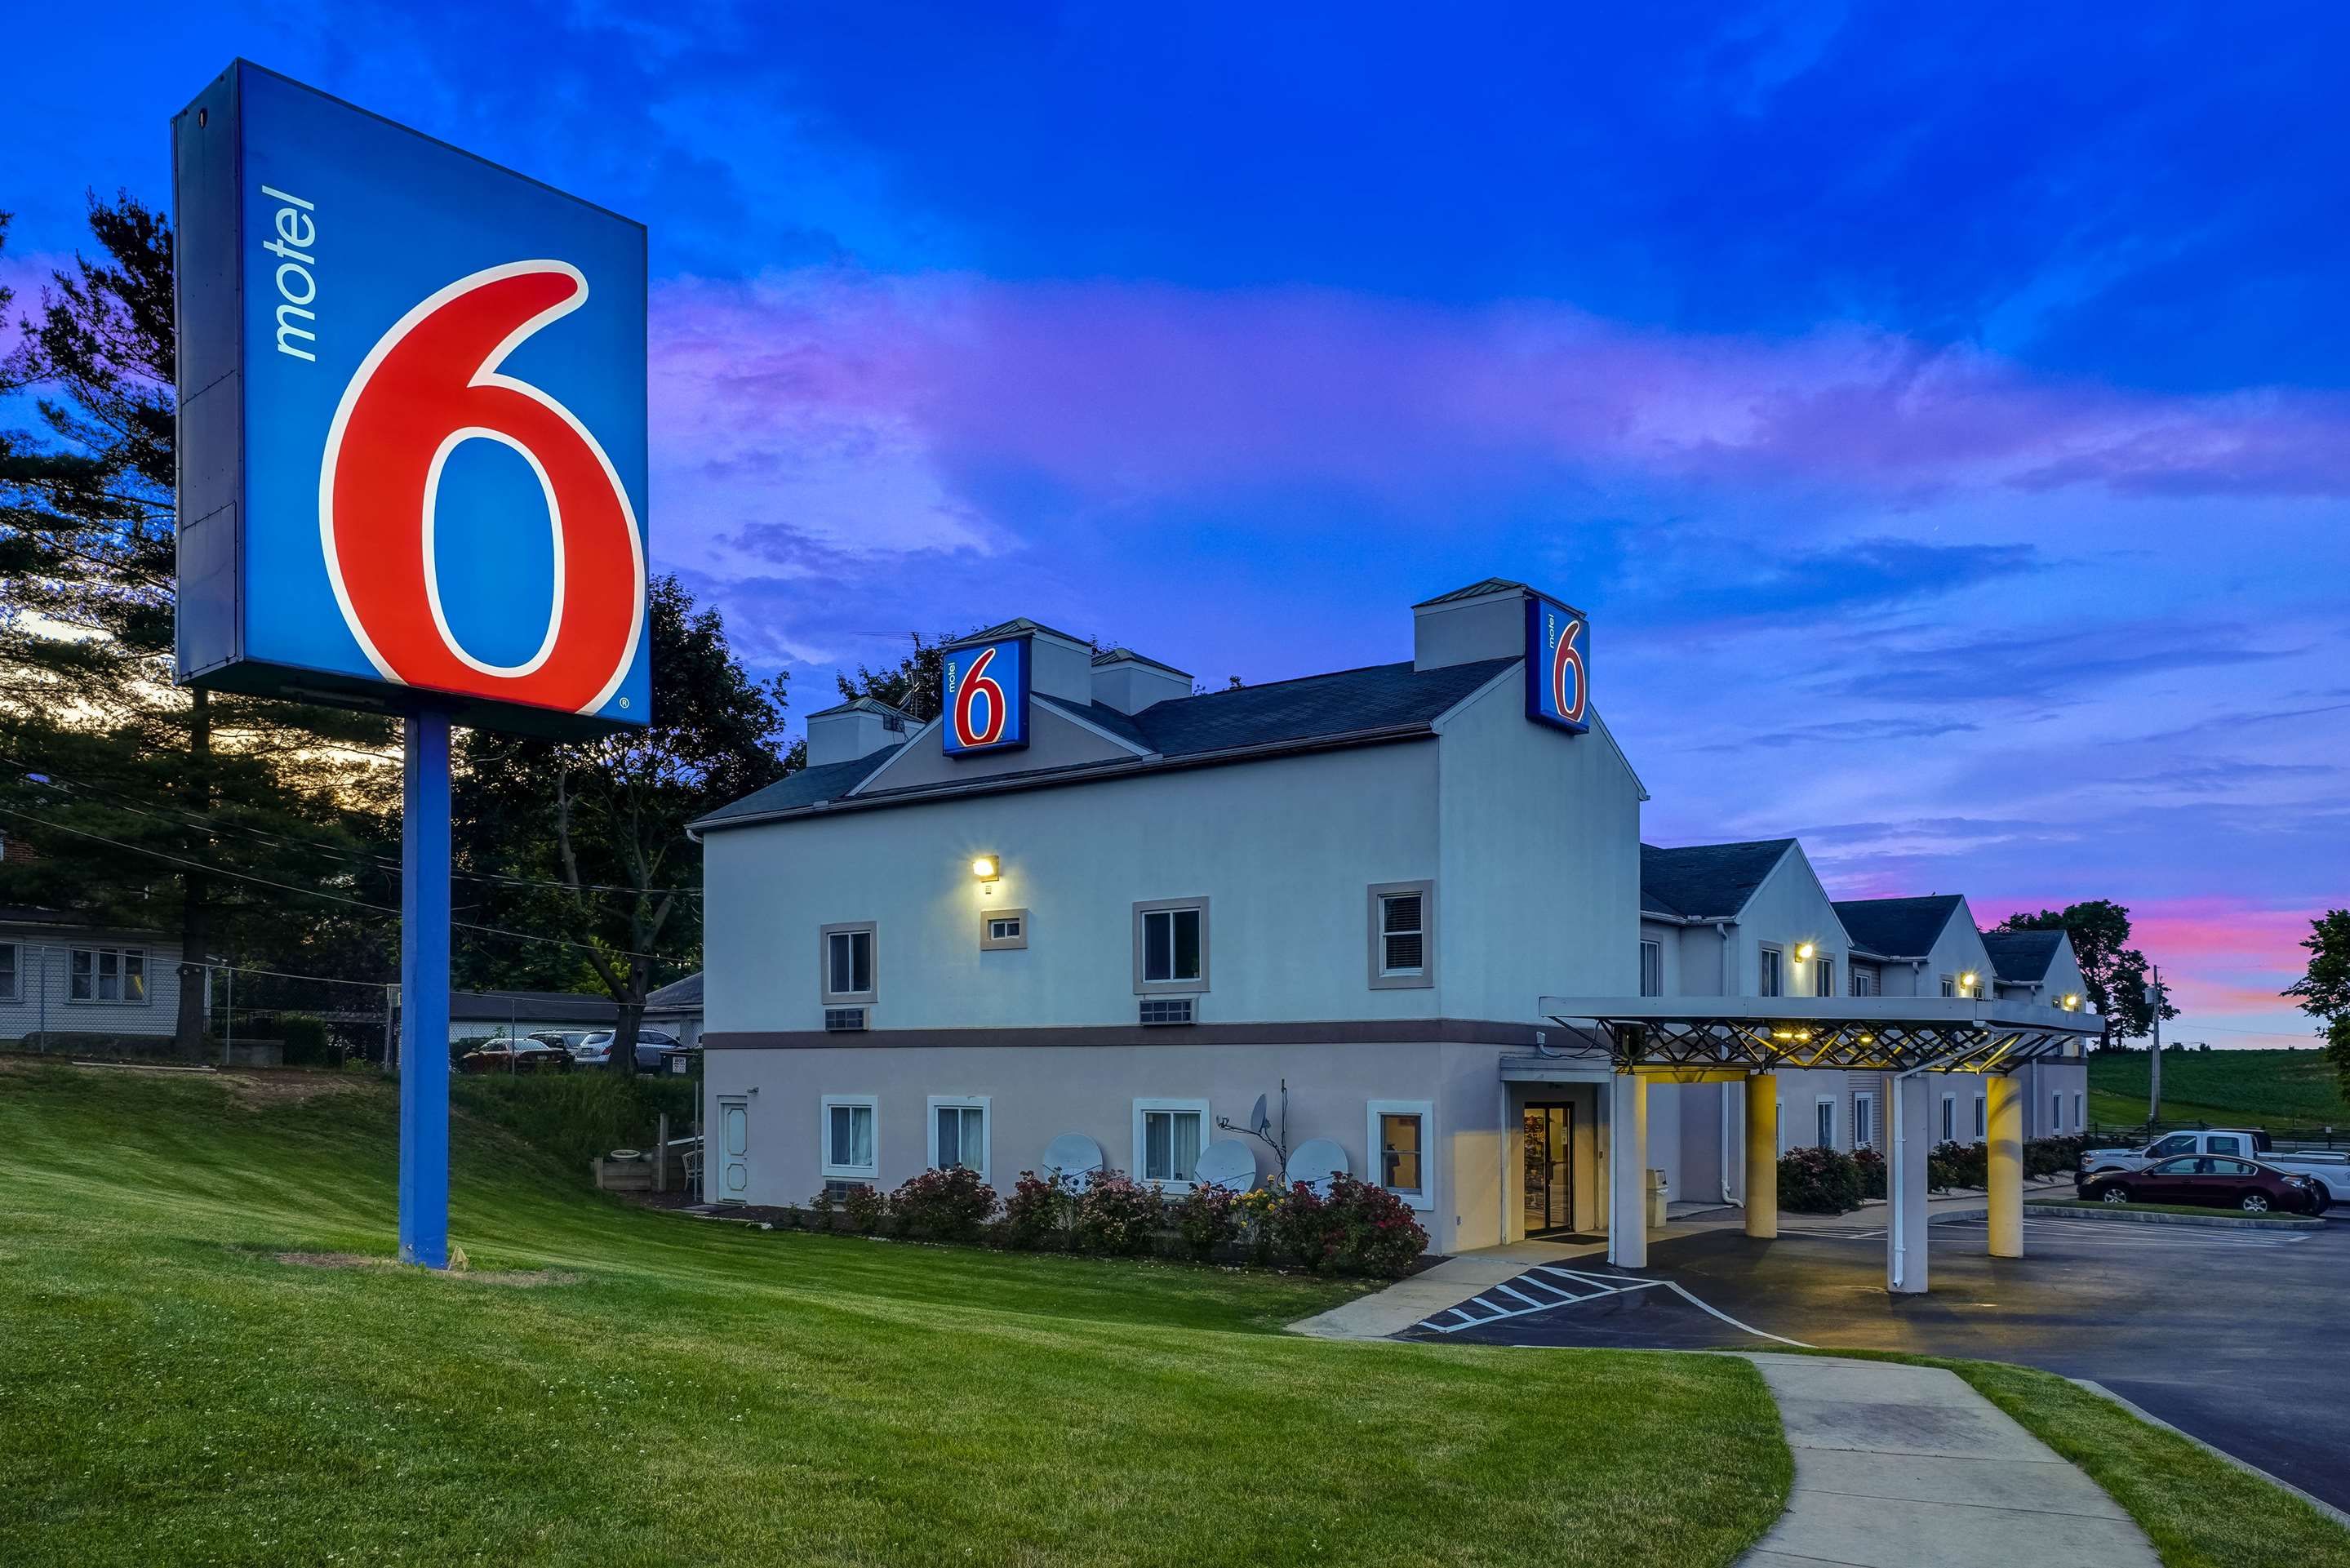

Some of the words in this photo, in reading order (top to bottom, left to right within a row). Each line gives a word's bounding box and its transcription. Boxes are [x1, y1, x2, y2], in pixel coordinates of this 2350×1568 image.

[262, 185, 315, 362] motel
[318, 259, 645, 716] 6
[948, 662, 956, 692] motel
[954, 647, 1006, 747] 6
[1553, 620, 1586, 722] 6
